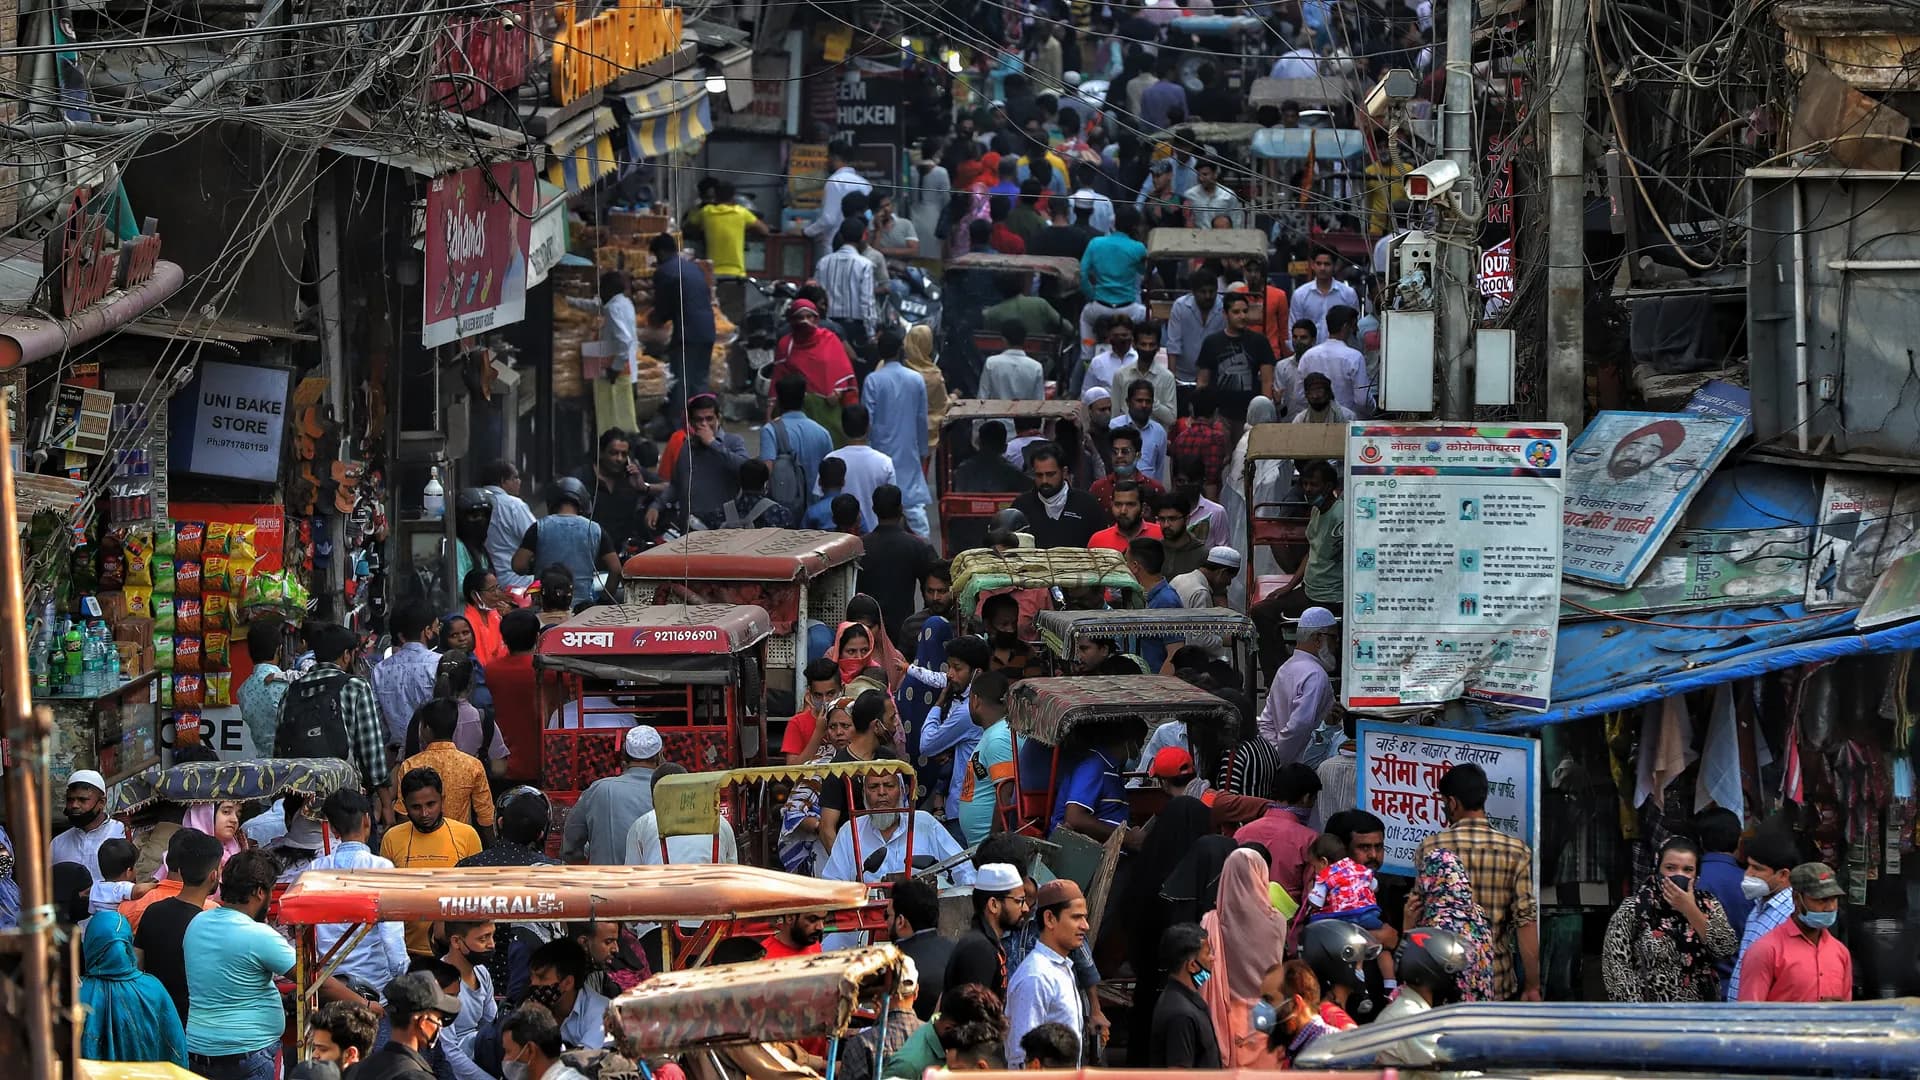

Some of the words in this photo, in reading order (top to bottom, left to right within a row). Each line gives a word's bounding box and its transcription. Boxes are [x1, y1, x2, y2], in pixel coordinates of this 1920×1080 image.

[203, 392, 231, 408] UNI
[236, 397, 282, 415] BAKE
[211, 415, 268, 434] STORE
[1391, 441, 1421, 451] नोवल
[1446, 441, 1521, 454] कोरोनावायरस
[1576, 494, 1617, 510] विकास
[1619, 501, 1649, 513] कार्य
[561, 631, 615, 648] अम्बा
[654, 630, 718, 641] 9211696901
[1455, 743, 1503, 765] सीताराम
[1370, 753, 1420, 787] सीमा
[1370, 788, 1430, 825] महमूद
[438, 895, 533, 916] THUKRAL
